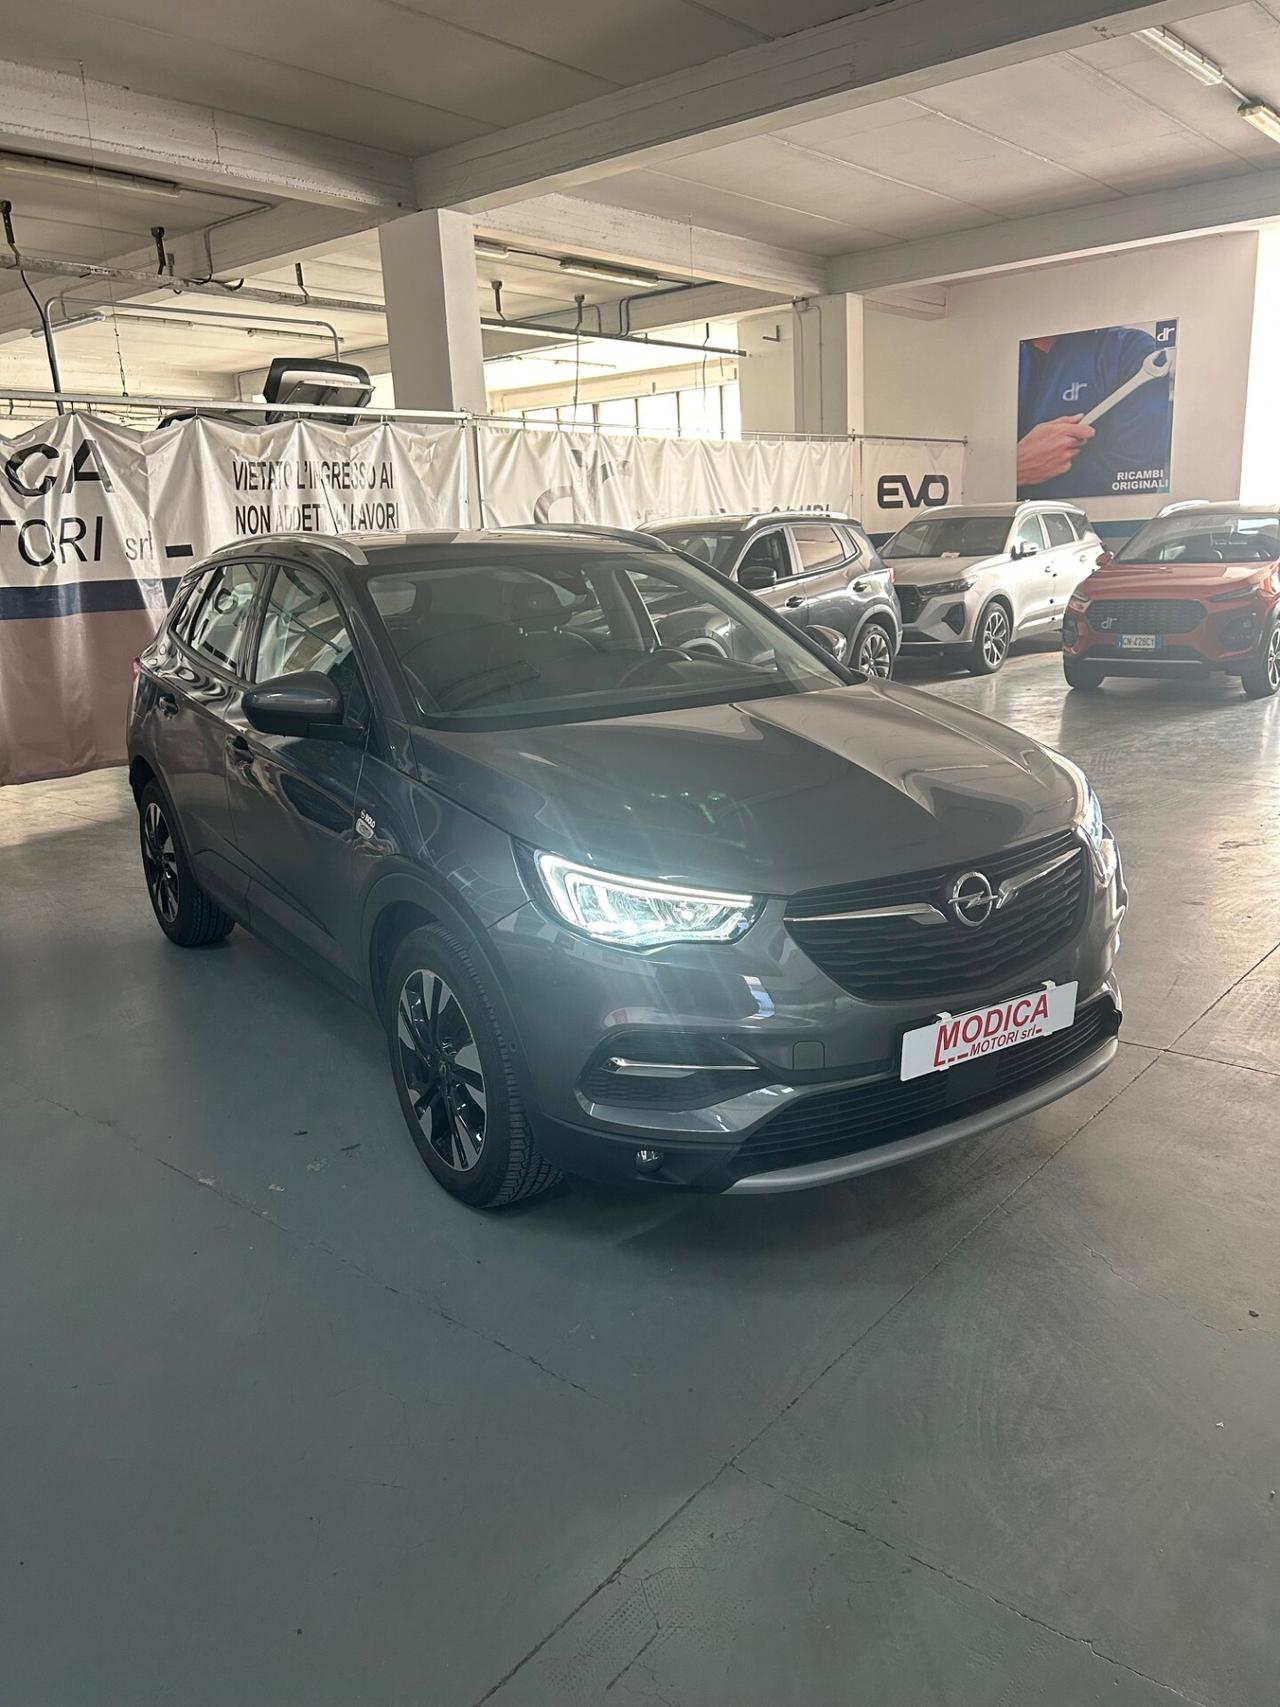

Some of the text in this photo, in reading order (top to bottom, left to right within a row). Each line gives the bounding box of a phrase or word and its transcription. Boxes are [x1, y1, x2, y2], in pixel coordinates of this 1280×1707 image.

[1156, 327, 1175, 342] dr
[1062, 382, 1088, 401] dr
[232, 460, 294, 491] VIETATO
[380, 461, 394, 489] AI
[1111, 478, 1169, 491] ORIGINALI
[1116, 469, 1164, 481] RICAMBI
[877, 474, 949, 509] EVO
[235, 504, 271, 535] NON
[350, 502, 399, 530] LAVORI
[1101, 616, 1118, 629] dr
[934, 994, 1049, 1066] MODICA
[969, 1024, 1037, 1057] MOTORI srl
